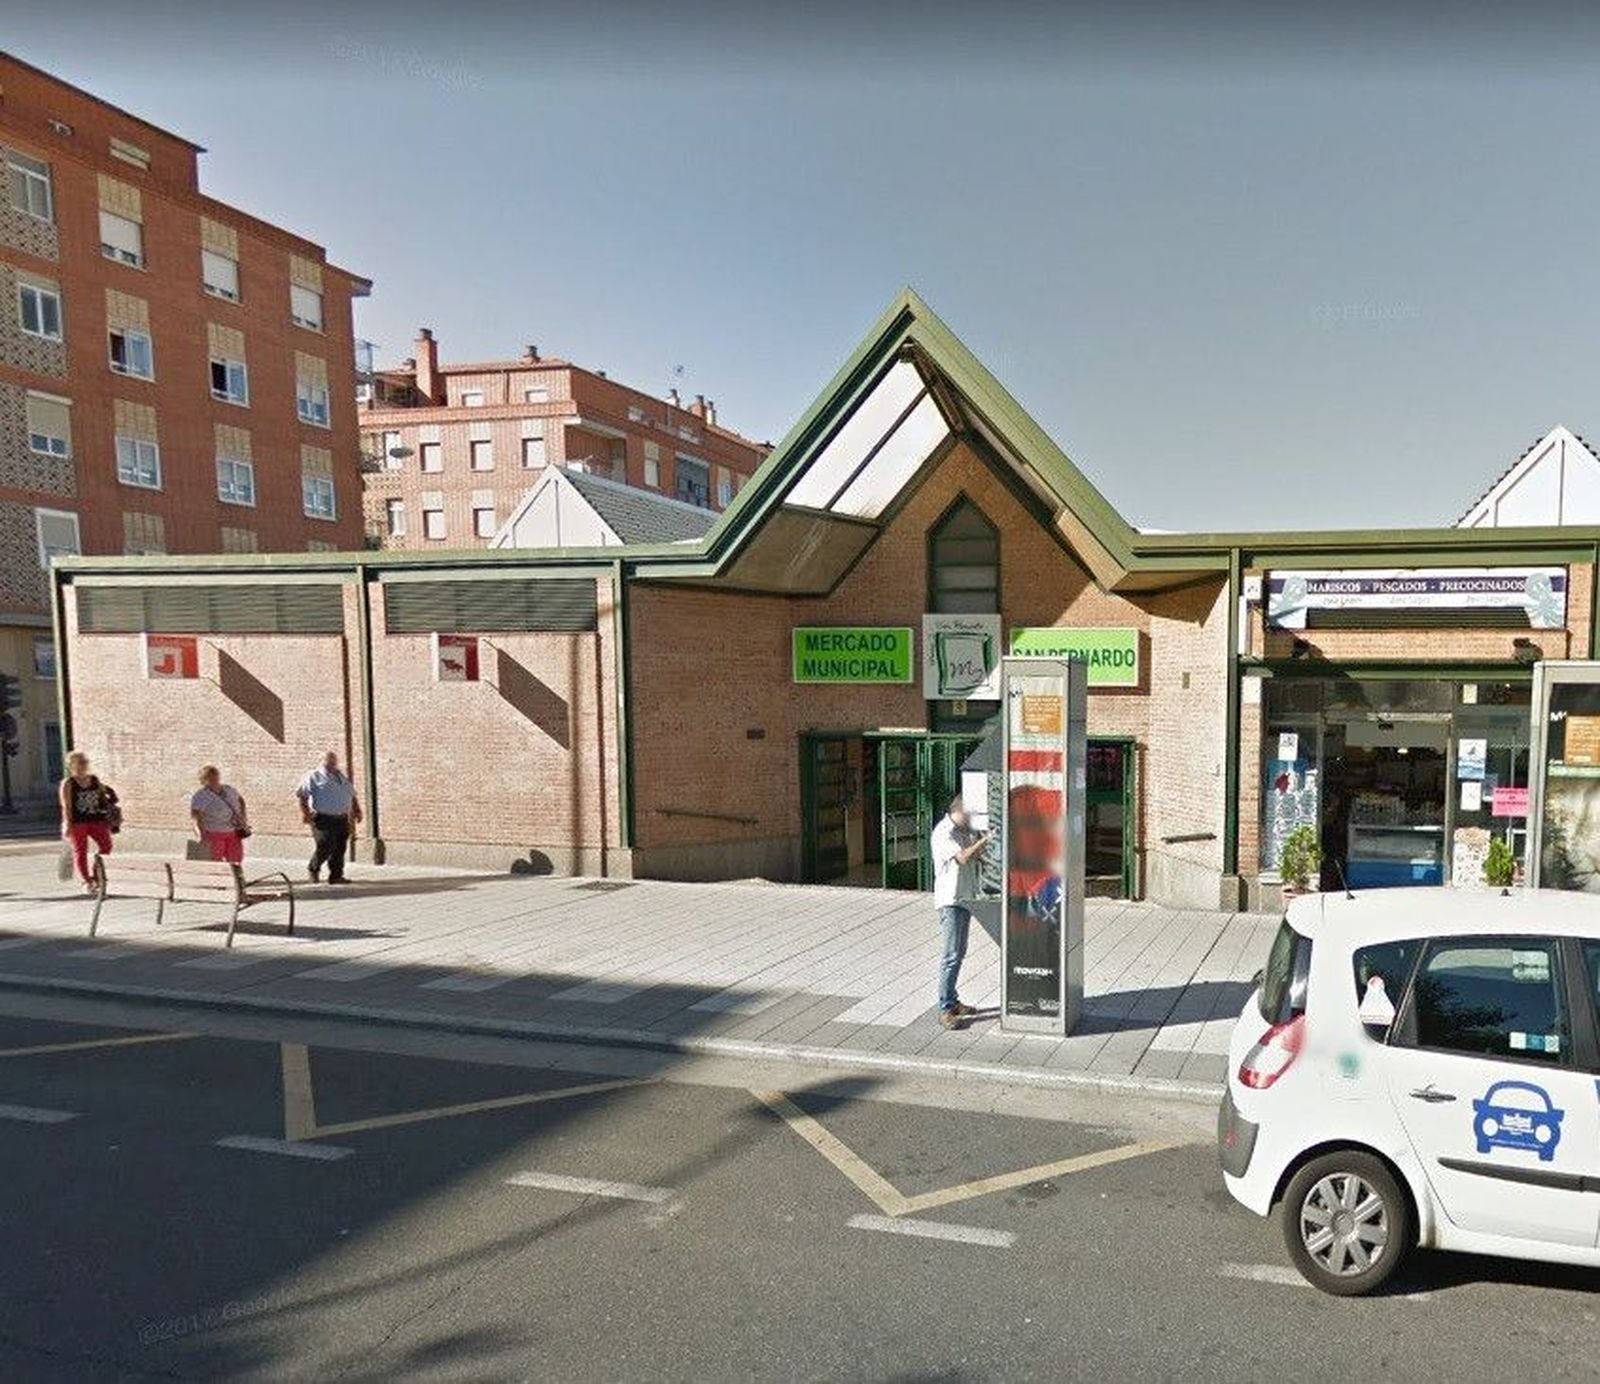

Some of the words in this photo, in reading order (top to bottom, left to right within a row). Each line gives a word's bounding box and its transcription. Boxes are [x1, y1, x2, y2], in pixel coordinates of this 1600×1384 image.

[1307, 581, 1360, 593] MARISCOS
[1373, 581, 1427, 592] PESCADOS
[1440, 580, 1525, 592] PRECOCINADOS
[806, 634, 897, 651] MERCADO
[803, 660, 899, 677] MUNICIPAL
